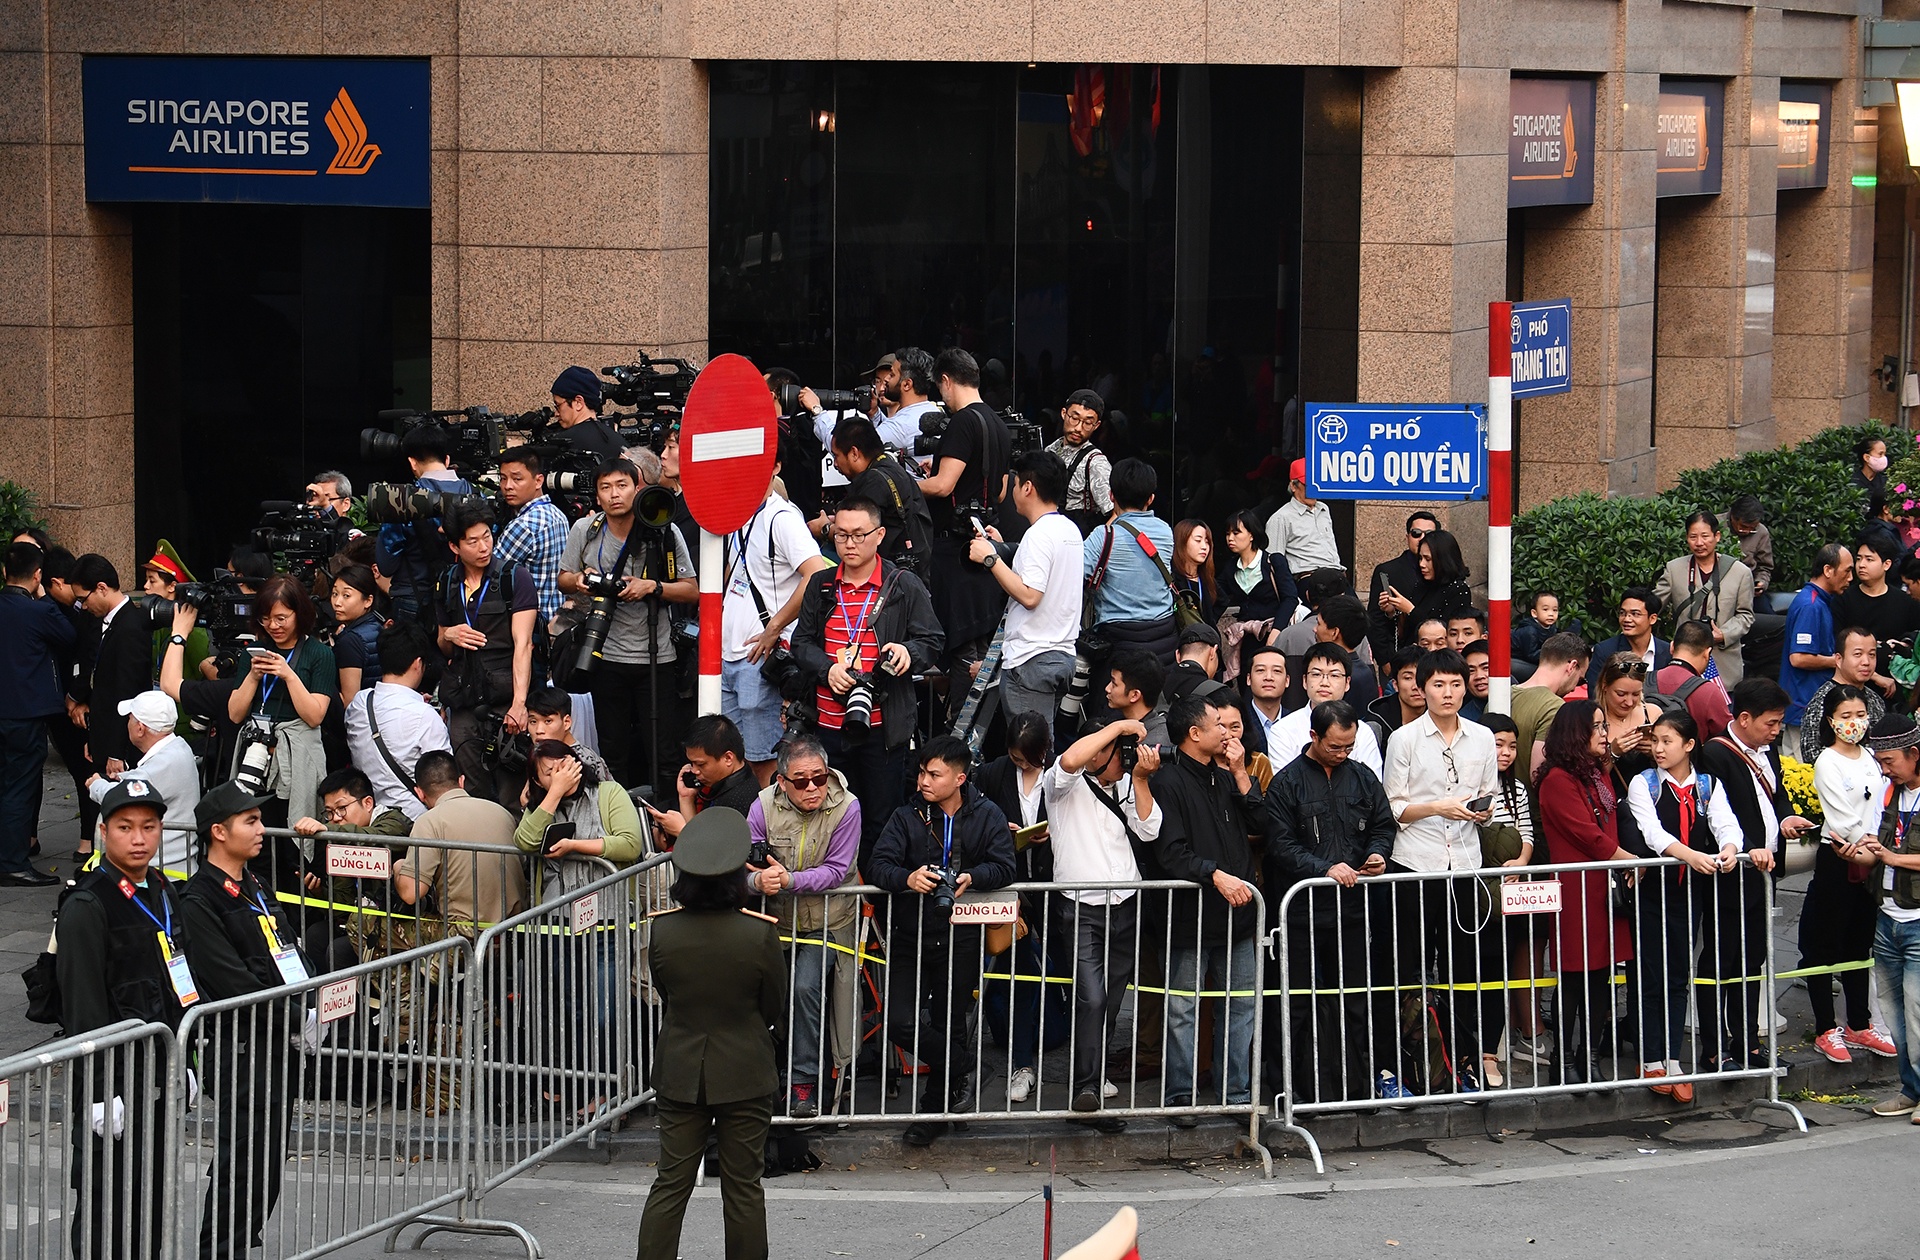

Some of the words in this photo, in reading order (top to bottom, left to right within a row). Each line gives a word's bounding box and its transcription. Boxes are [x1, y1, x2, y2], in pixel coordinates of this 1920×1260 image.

[128, 100, 309, 126] SINGAPORE
[1657, 114, 1697, 134] SINGAPORE
[1513, 115, 1561, 137] SINGAPORE
[168, 129, 310, 155] AIRLINES
[1523, 141, 1561, 163] AIRLINES
[1665, 138, 1696, 157] AIRLINES
[1528, 312, 1548, 337] PHỐ
[1511, 343, 1543, 383] TRÀNG
[1545, 336, 1566, 378] TIỀN
[1369, 416, 1422, 440] PHỐ
[1320, 444, 1375, 483] NGÔ
[1383, 441, 1470, 486] QUYỀN
[332, 856, 364, 870] DỪNG
[366, 861, 385, 873] LẠI
[955, 903, 989, 916] DỪNG
[993, 905, 1013, 917] LẠI
[1507, 893, 1537, 906] DỪNG
[1539, 894, 1557, 906] LẠI
[579, 908, 594, 925] STOP
[323, 997, 343, 1013] DỪNG
[343, 994, 355, 1008] LẠI
